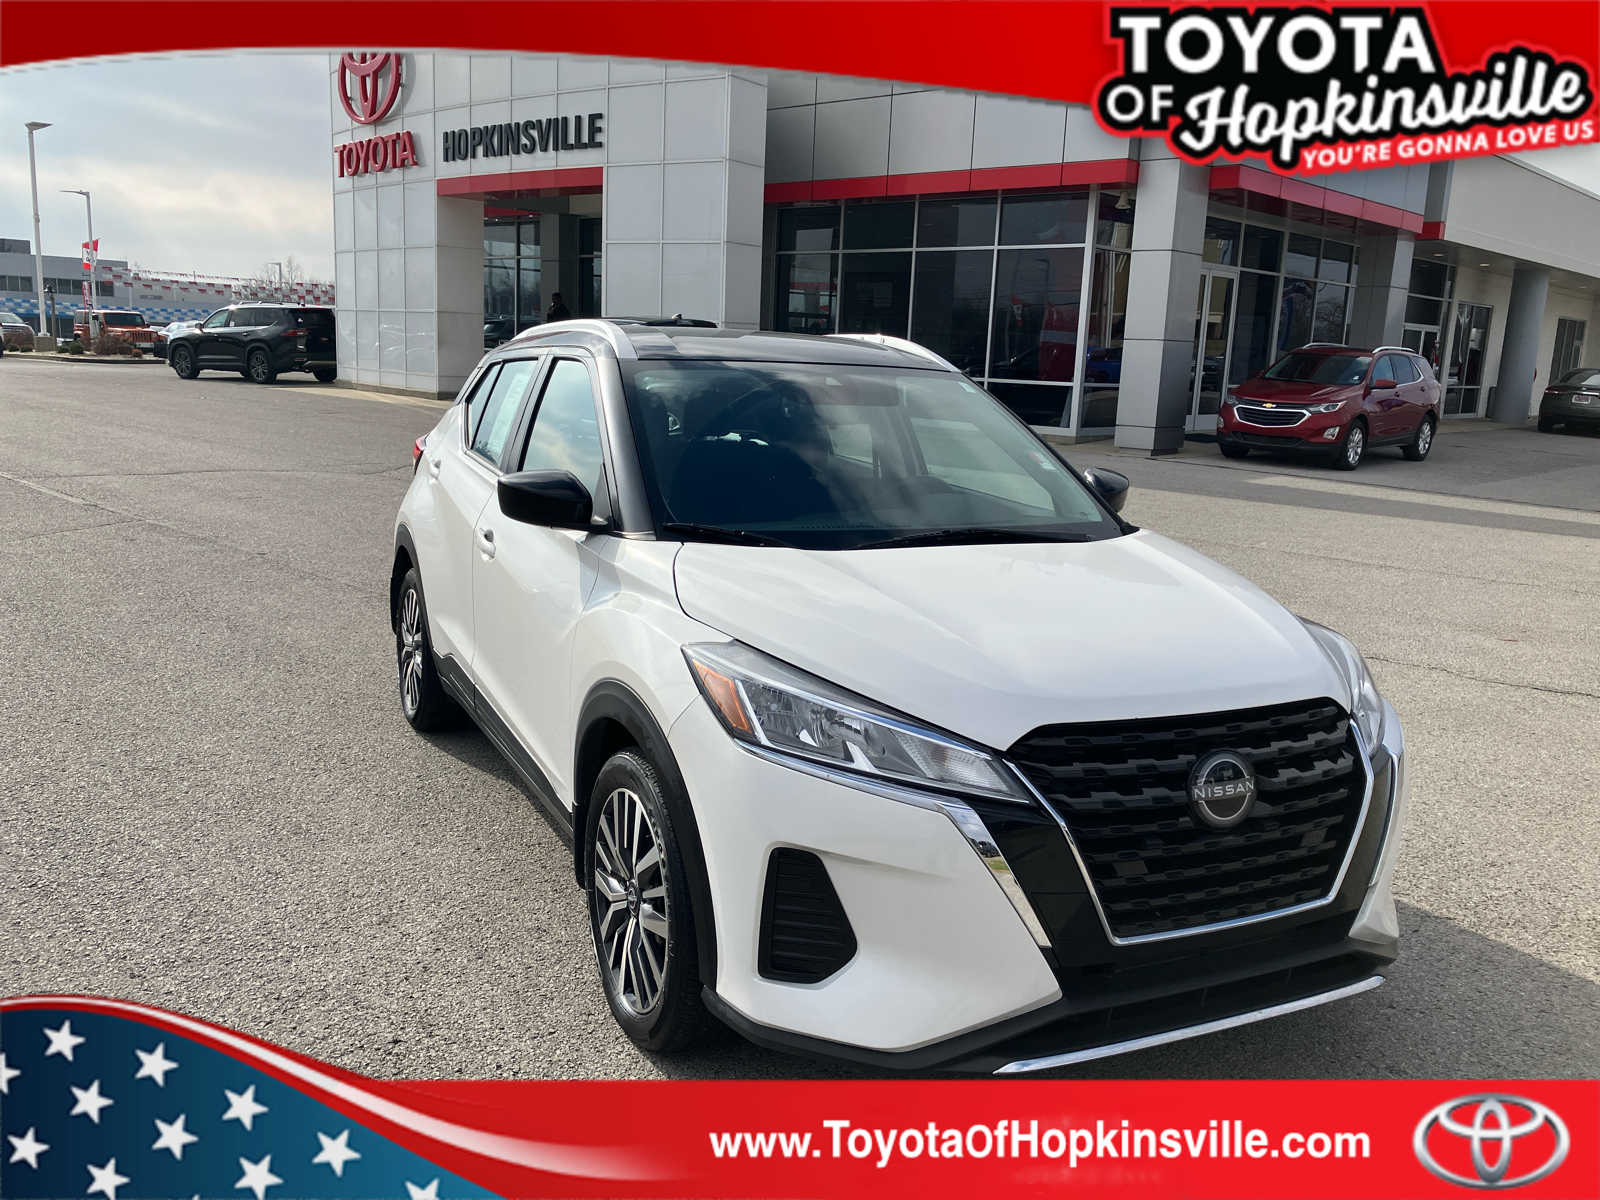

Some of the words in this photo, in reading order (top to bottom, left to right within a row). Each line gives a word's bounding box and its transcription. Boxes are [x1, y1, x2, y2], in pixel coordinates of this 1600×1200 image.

[334, 130, 418, 178] TOYOTA
[442, 112, 604, 163] HOPKINSVILLE
[1194, 780, 1254, 799] NISSAN
